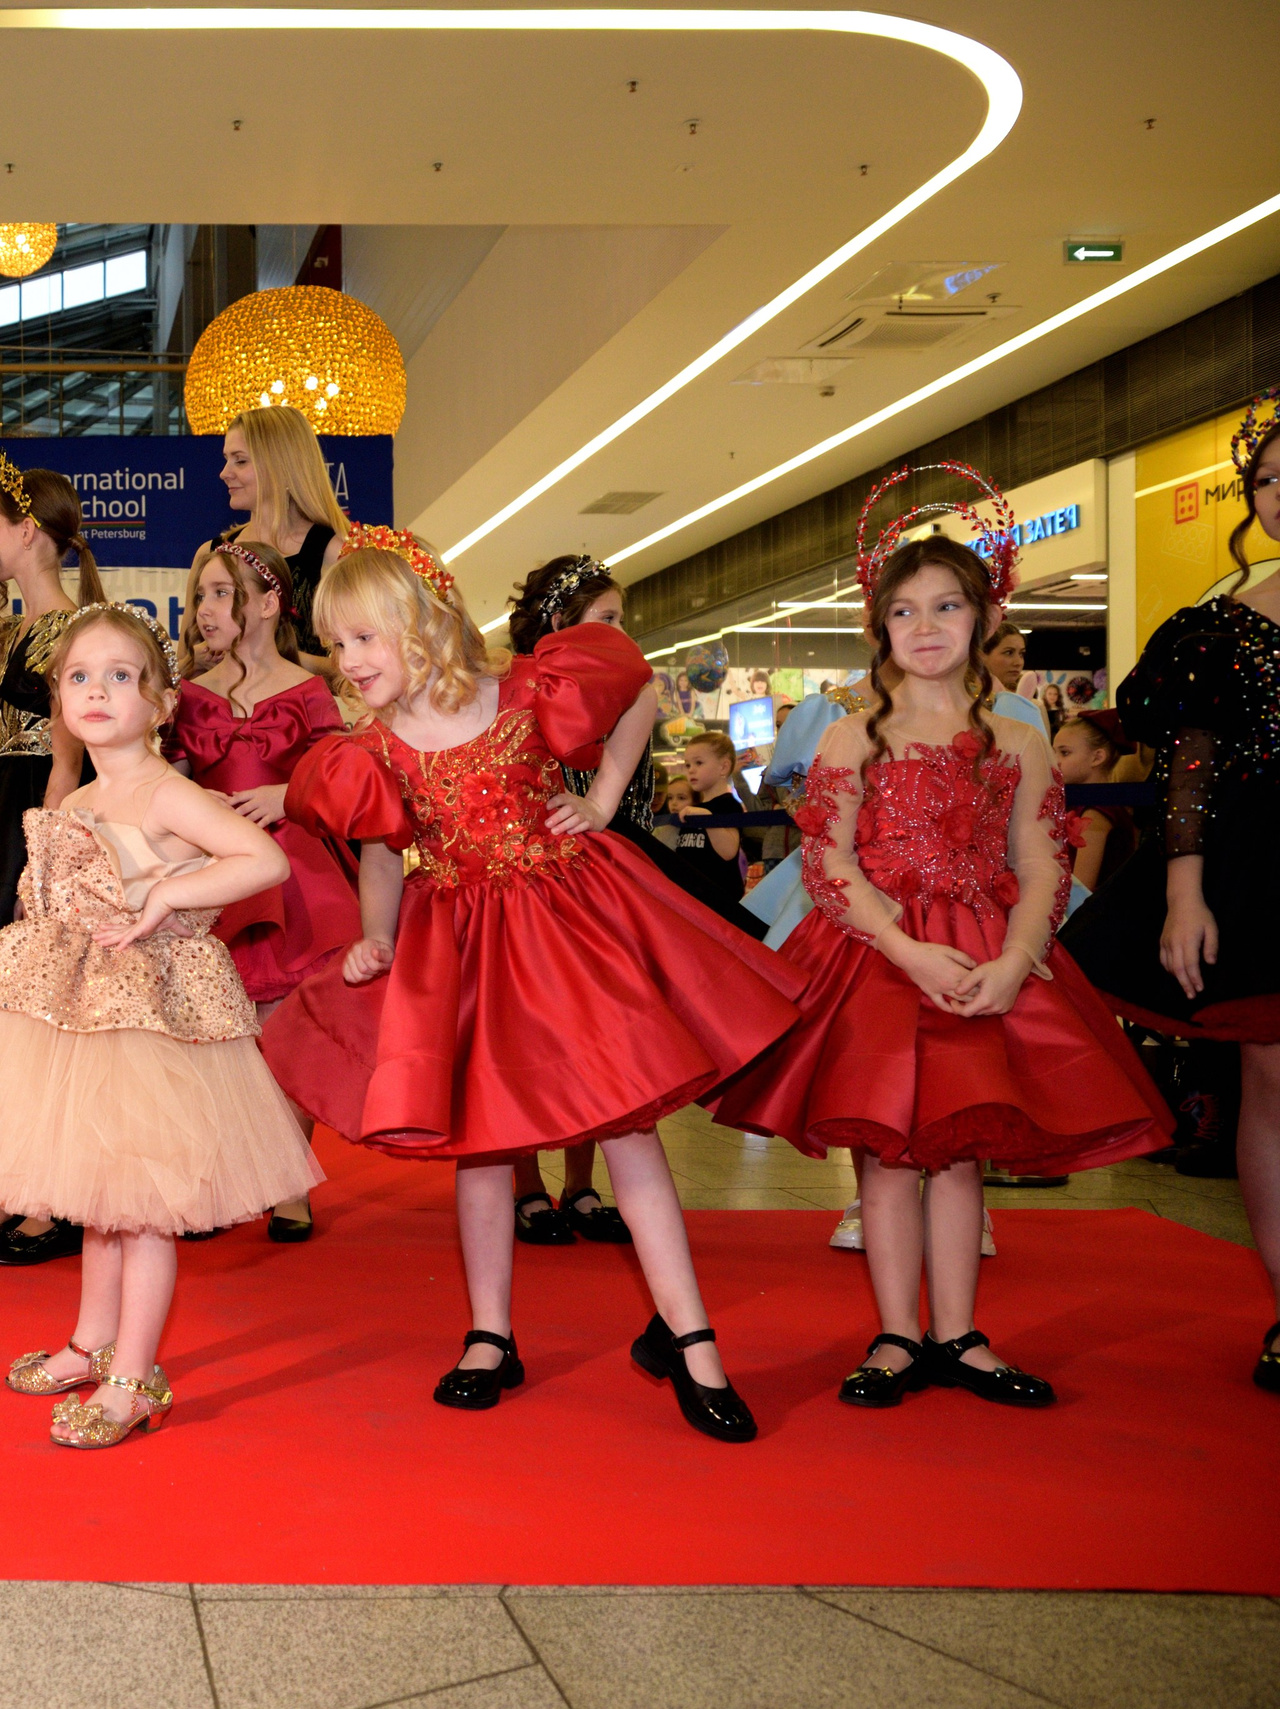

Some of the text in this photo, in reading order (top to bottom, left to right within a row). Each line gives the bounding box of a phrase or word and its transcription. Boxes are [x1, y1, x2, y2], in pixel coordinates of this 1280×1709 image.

[81, 494, 146, 518] chool
[91, 529, 146, 540] Petersburg
[1023, 503, 1080, 545] ЗАТЕЯ
